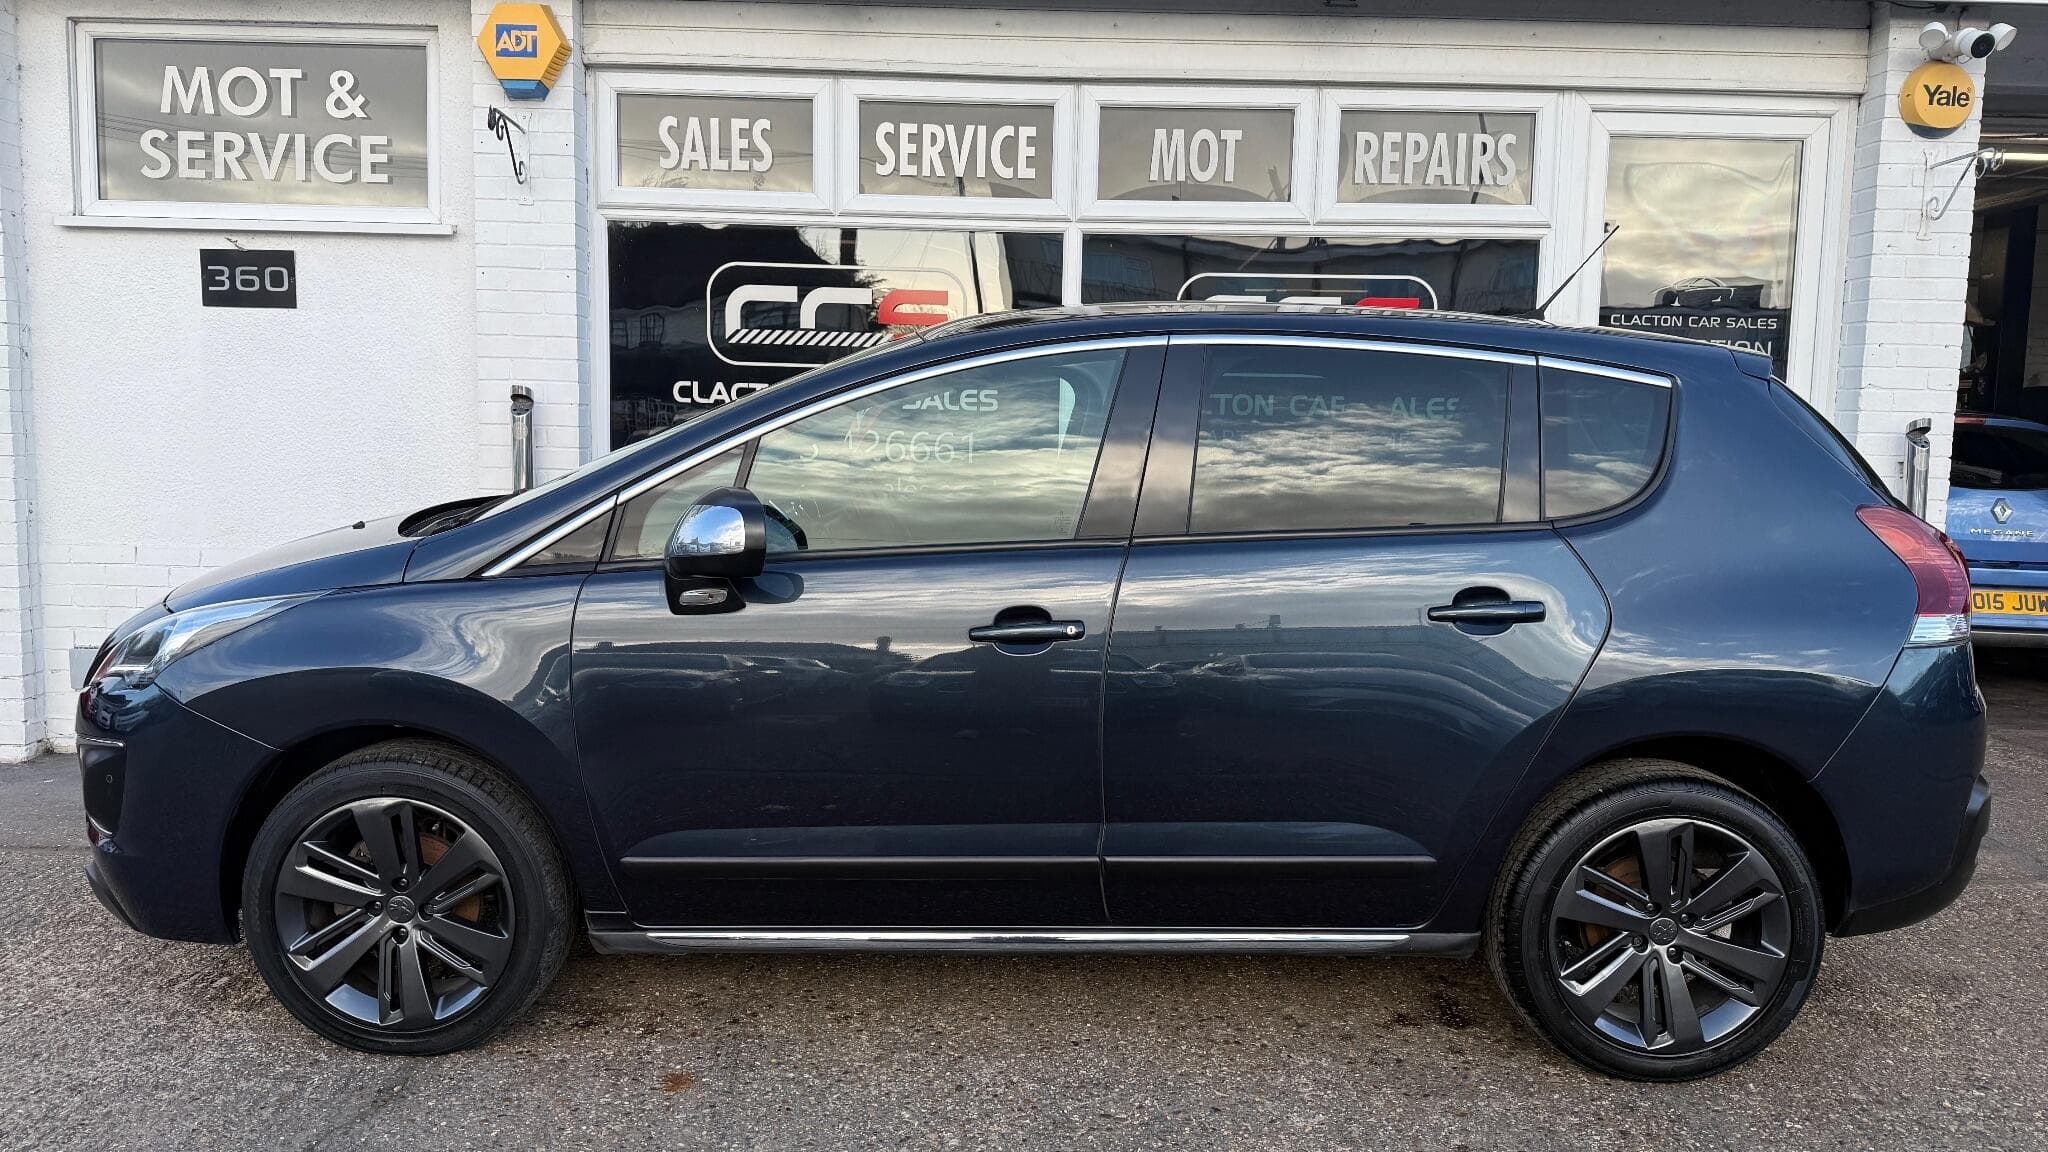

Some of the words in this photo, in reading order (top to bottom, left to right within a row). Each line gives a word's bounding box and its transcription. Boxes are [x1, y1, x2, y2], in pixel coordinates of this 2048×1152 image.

[496, 30, 538, 52] ADT
[160, 65, 303, 118] MOT
[325, 69, 368, 119] &
[1923, 84, 1970, 107] Yale
[139, 129, 389, 184] SERVICE
[658, 115, 774, 173] SALES
[876, 121, 1037, 180] SERVICE
[1149, 128, 1243, 183] MOT
[1354, 131, 1517, 187] REPAIRS
[207, 265, 289, 292] 360
[1610, 313, 1683, 327] CLACTON
[1688, 316, 1721, 328] CAR
[1726, 317, 1778, 330] SALES
